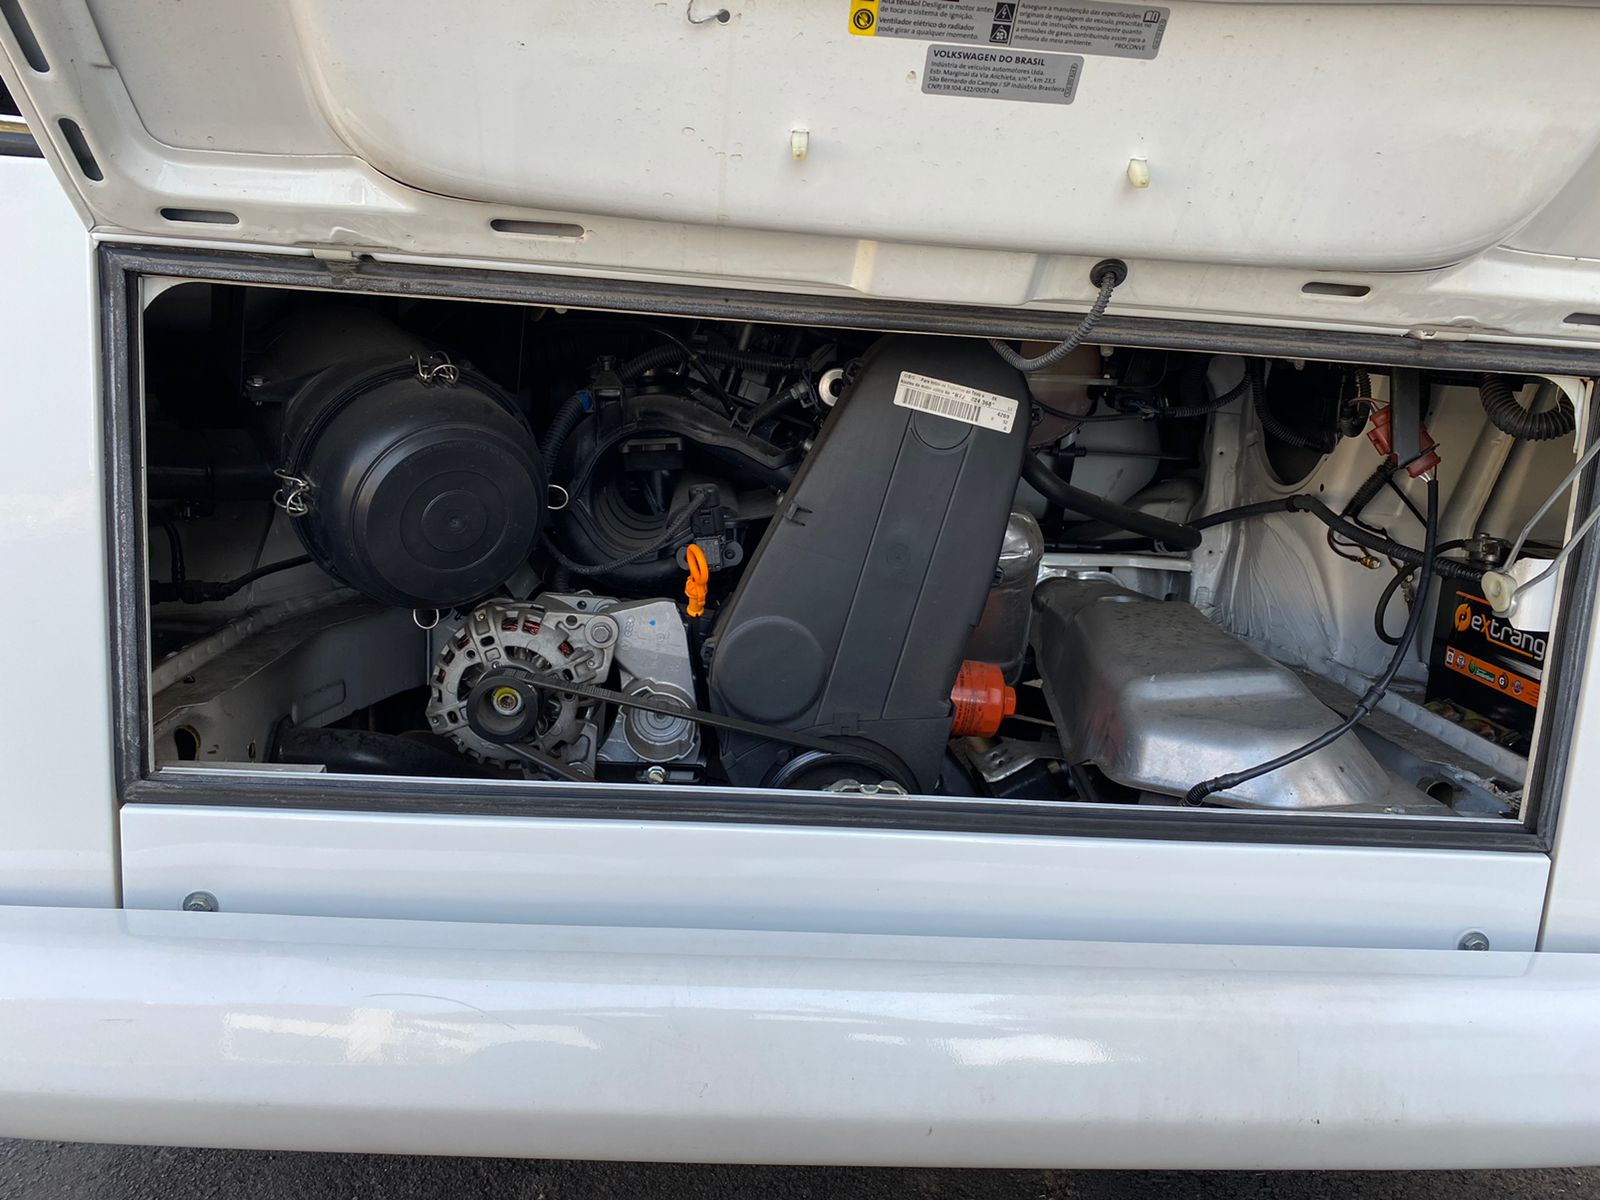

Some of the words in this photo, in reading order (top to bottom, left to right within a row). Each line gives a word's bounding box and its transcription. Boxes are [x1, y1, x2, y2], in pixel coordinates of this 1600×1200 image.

[922, 0, 948, 10] Desligar
[1020, 3, 1047, 11] Assegure
[1053, 6, 1090, 14] manutenção
[1101, 10, 1142, 19] especificações
[878, 16, 912, 26] Ventilador
[913, 19, 937, 28] elétrico
[948, 22, 976, 31] radiador
[1053, 14, 1084, 22] regulagem
[1115, 20, 1143, 28] prescritas
[917, 29, 945, 38] qualquer
[1080, 25, 1120, 34] especialmente
[1074, 32, 1110, 40] contribuindo
[1114, 42, 1146, 51] PROCONVE
[933, 49, 997, 62] VOLKSWAGEN
[998, 54, 1013, 64] DO
[1014, 56, 1046, 66] BRASIL
[930, 61, 958, 69] Indústria
[968, 64, 991, 72] veículos
[992, 66, 1030, 74] automotores
[943, 69, 970, 78] Marginal
[940, 76, 968, 84] Bernardo
[977, 80, 998, 88] Campo
[1011, 82, 1038, 90] Indústria
[1038, 84, 1066, 92] Brasileira
